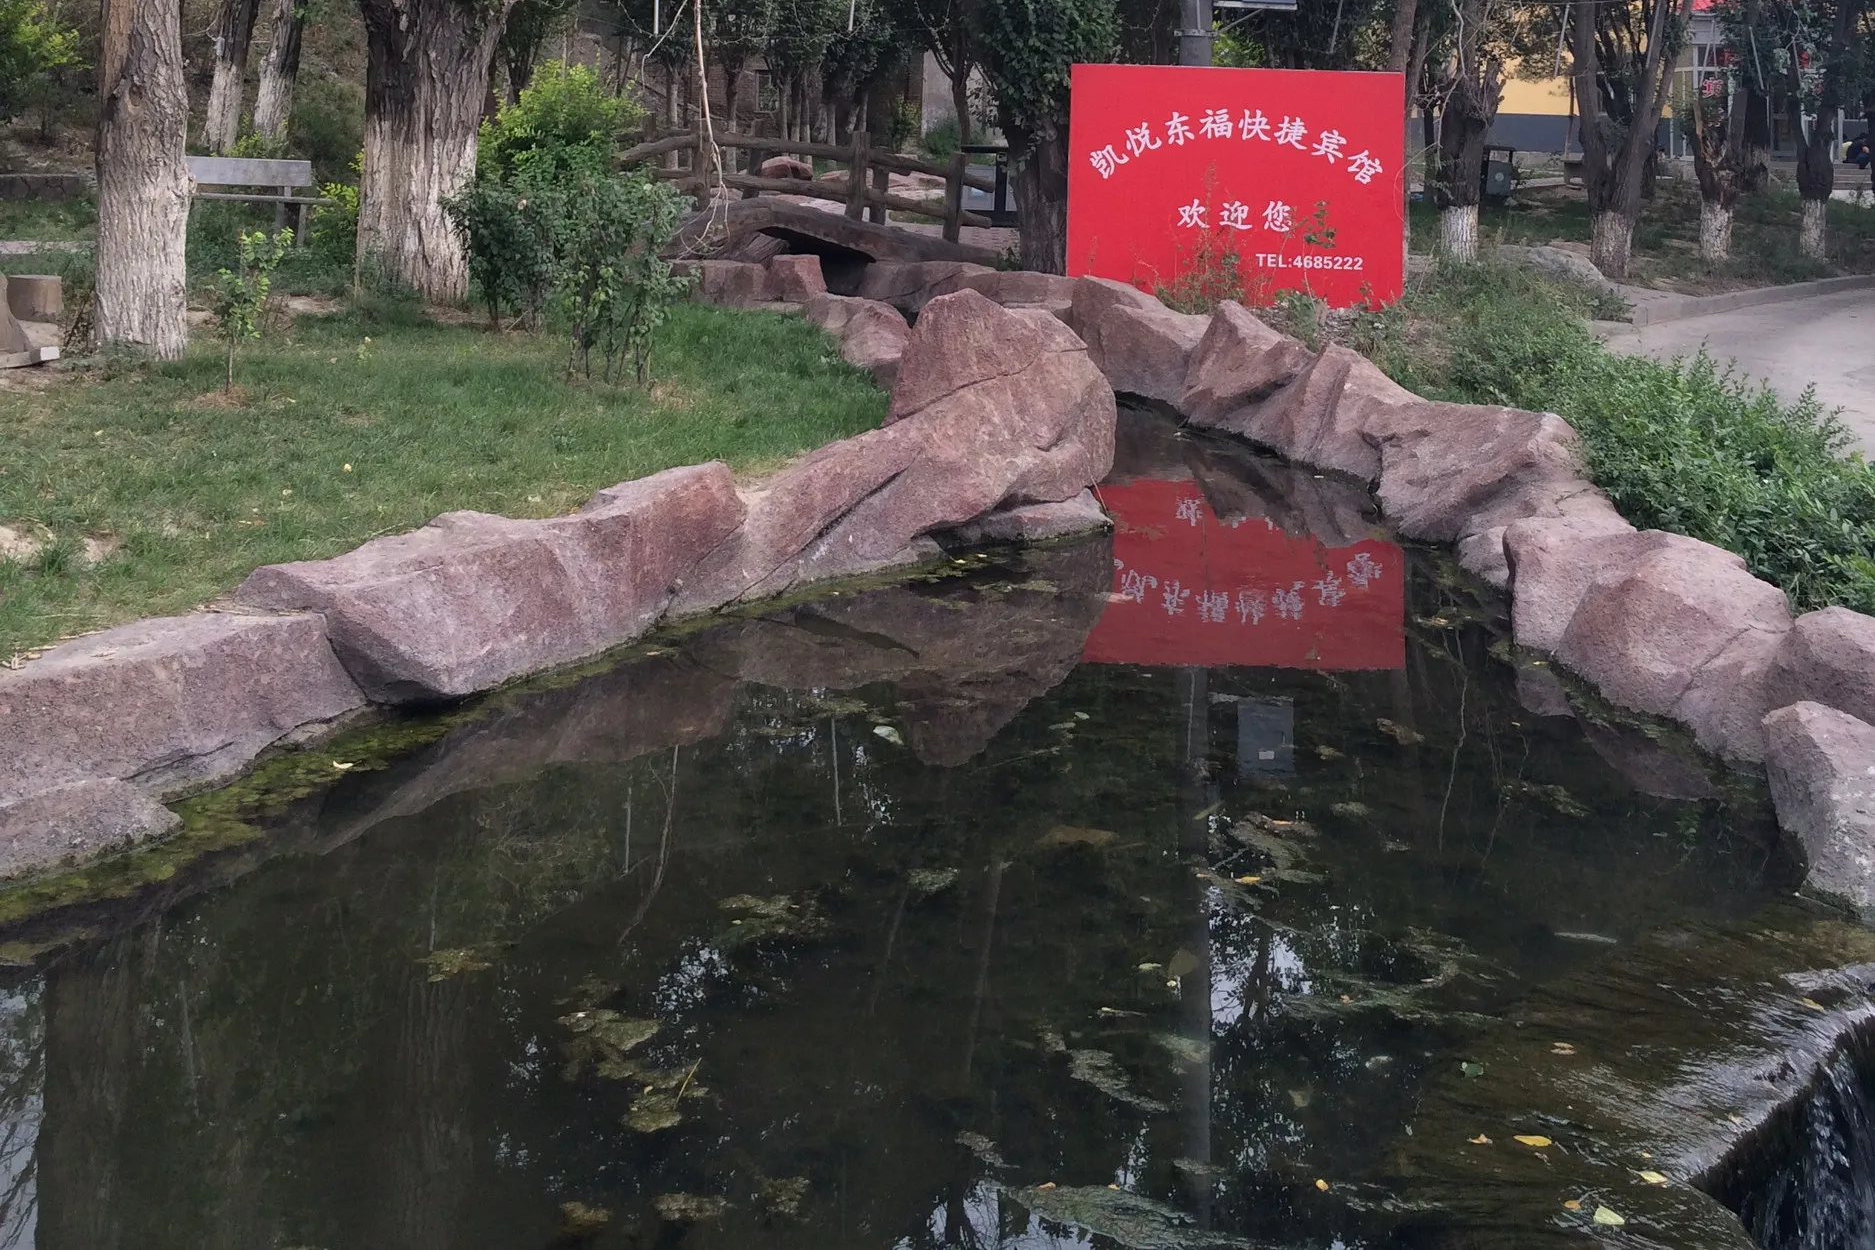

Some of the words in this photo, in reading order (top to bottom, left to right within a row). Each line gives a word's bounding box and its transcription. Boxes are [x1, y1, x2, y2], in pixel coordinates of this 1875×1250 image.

[1088, 108, 1384, 185] 凯悦东福快捷宾馆
[1176, 198, 1292, 232] 欢迎您
[1255, 252, 1364, 271] TEL:4685222
